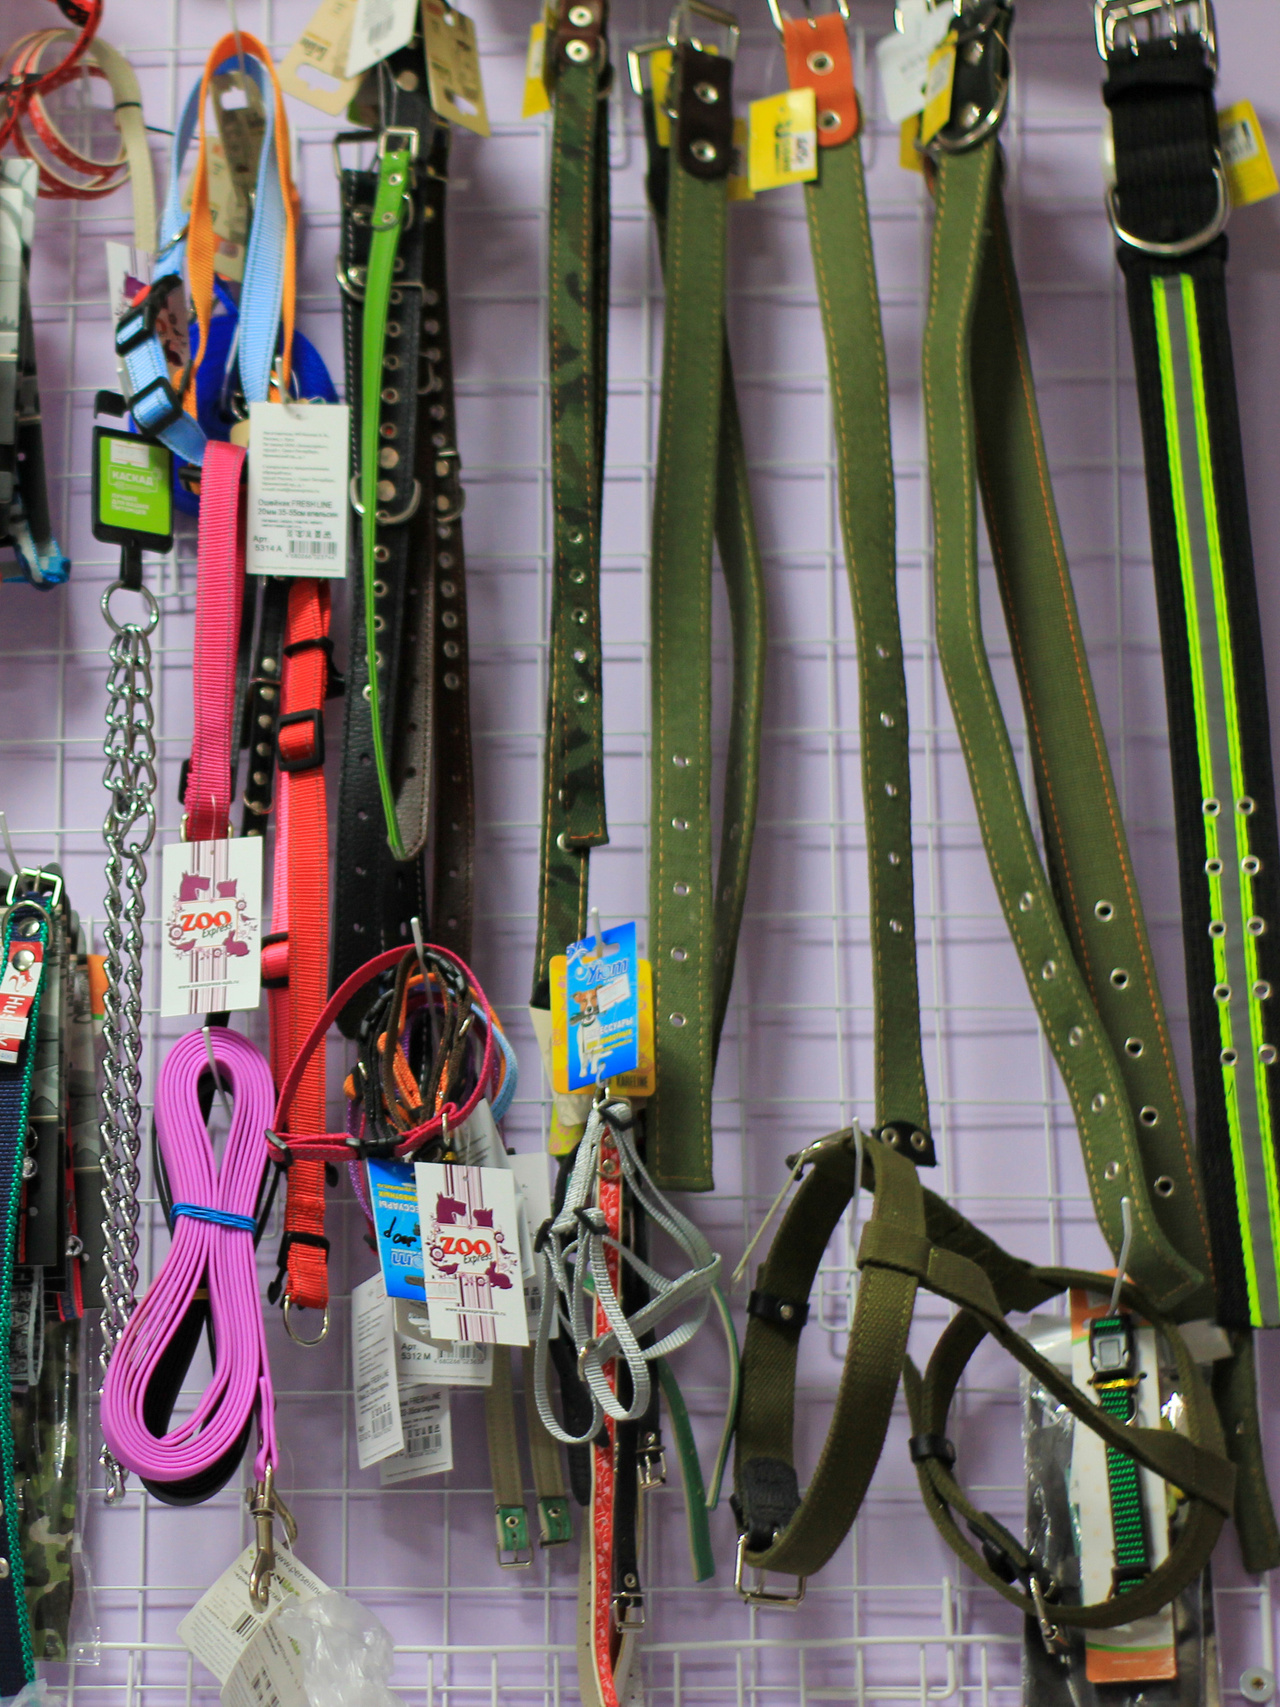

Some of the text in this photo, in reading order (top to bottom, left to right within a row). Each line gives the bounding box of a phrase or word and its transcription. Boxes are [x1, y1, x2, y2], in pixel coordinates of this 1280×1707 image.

[112, 470, 154, 487] КАСКАД
[292, 500, 316, 508] FRESH
[255, 544, 275, 552] 5314
[180, 910, 231, 932] ZOO
[202, 922, 233, 939] Express
[586, 958, 629, 985] Уют
[440, 1237, 491, 1255] ZOO
[463, 1253, 493, 1266] Express
